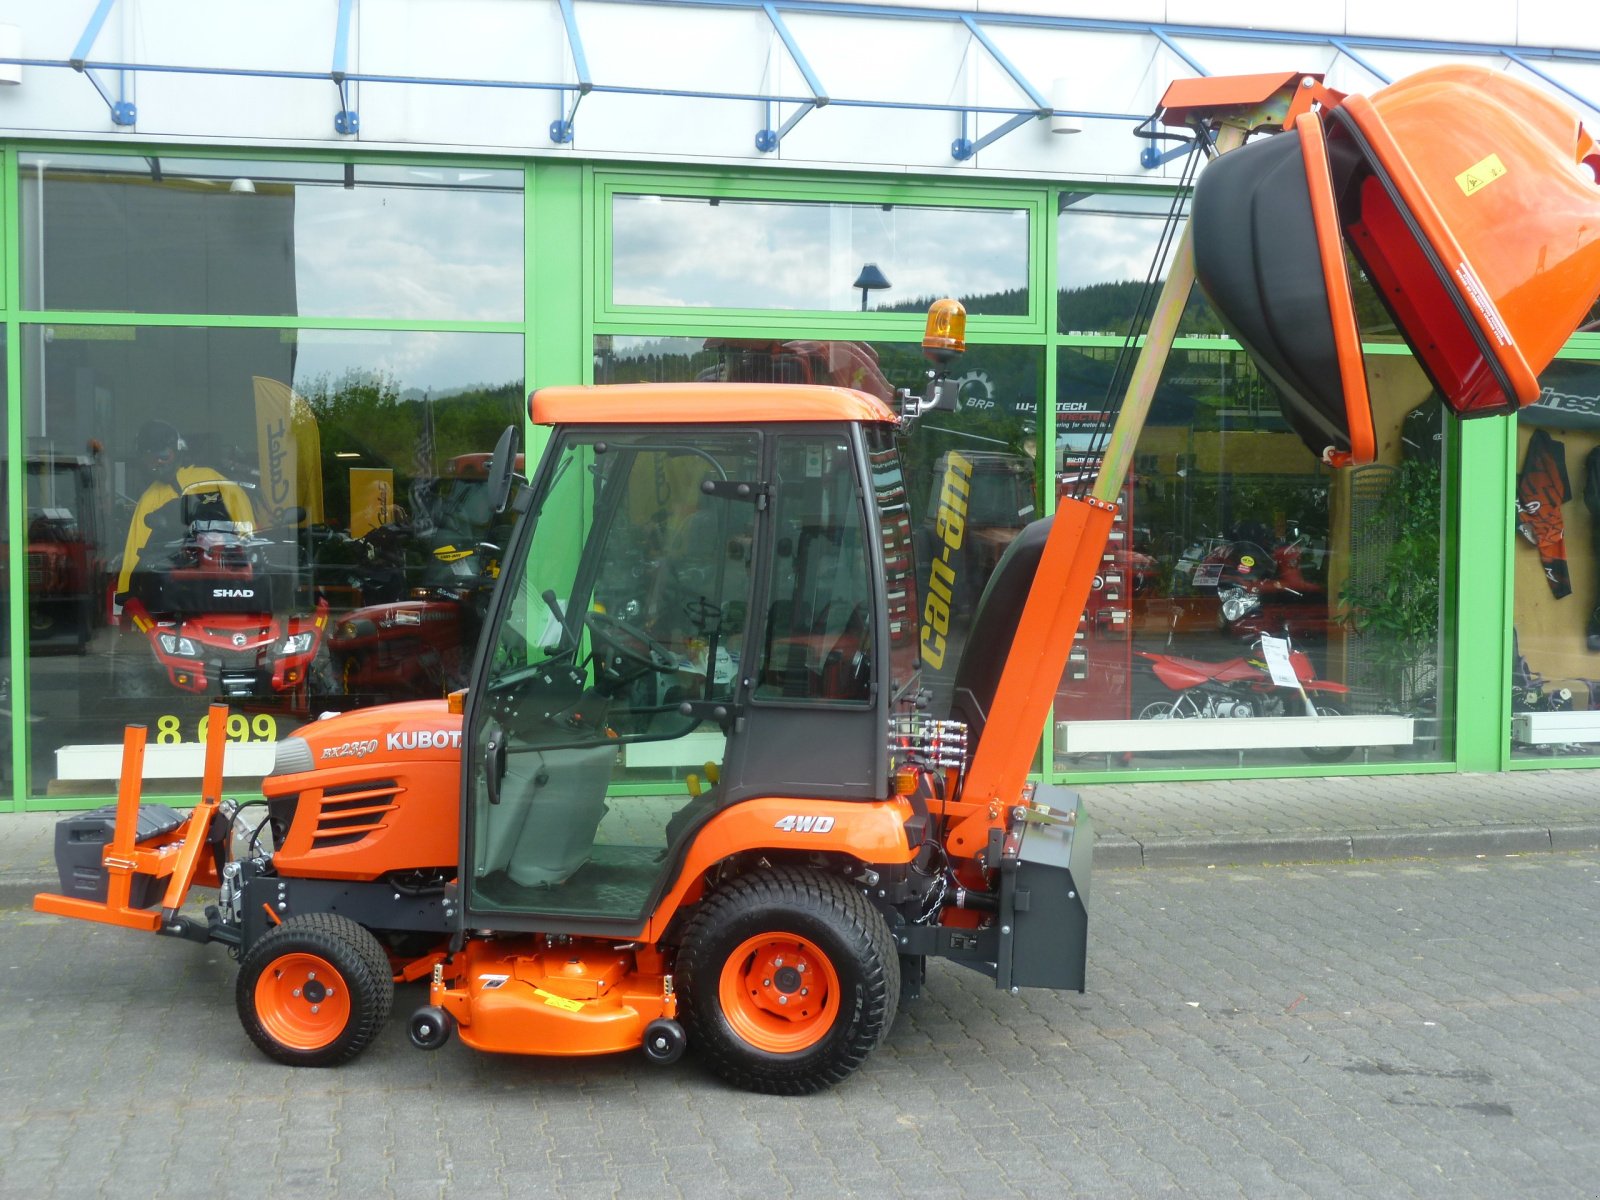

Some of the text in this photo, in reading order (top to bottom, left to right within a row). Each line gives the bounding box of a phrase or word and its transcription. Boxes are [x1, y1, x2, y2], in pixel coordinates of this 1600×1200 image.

[966, 397, 995, 410] BRP
[212, 588, 255, 599] SHAD
[320, 730, 462, 760] BX2350 KUBOT
[774, 815, 836, 834] 4WD
